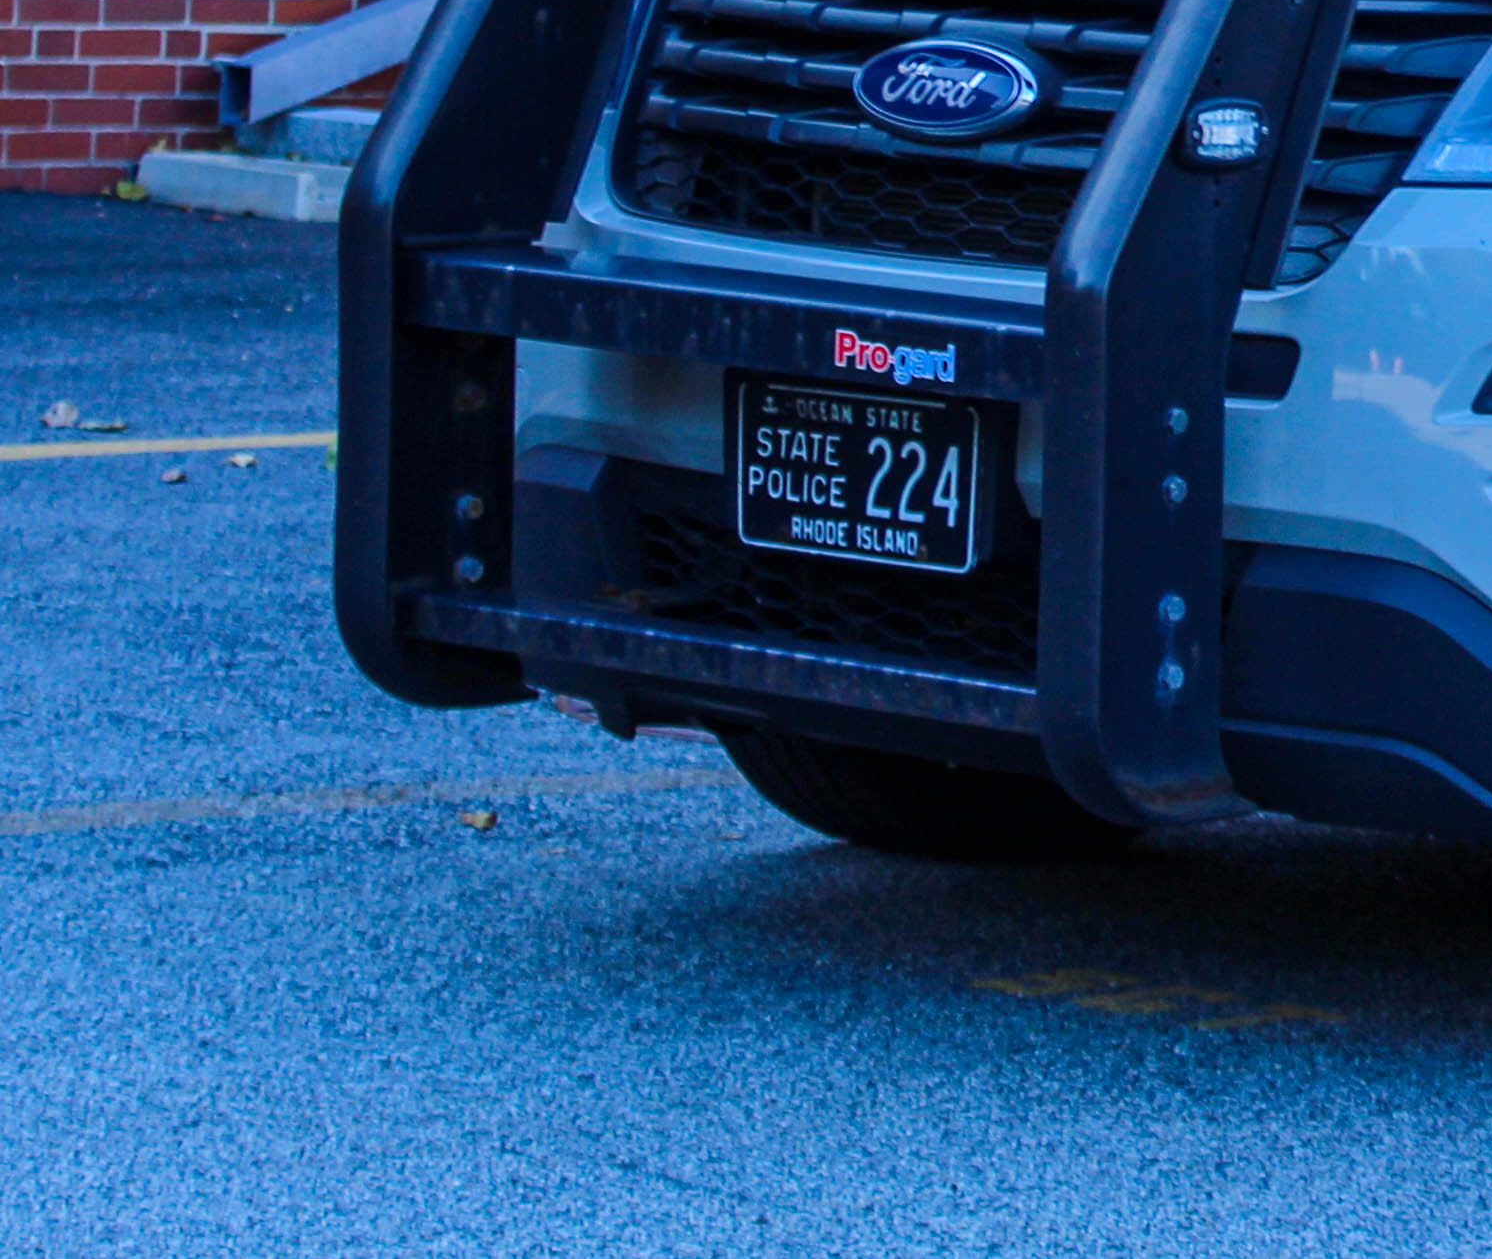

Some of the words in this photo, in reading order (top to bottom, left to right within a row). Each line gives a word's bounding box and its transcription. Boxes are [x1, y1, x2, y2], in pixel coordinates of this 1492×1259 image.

[881, 52, 986, 109] Ford
[796, 399, 853, 425] OCEAN
[867, 406, 923, 434] STATE
[757, 427, 841, 466] STATE
[749, 466, 846, 508] POLICE
[866, 437, 959, 527] 224
[791, 516, 849, 547] RHODE
[856, 524, 918, 556] ISLAND
